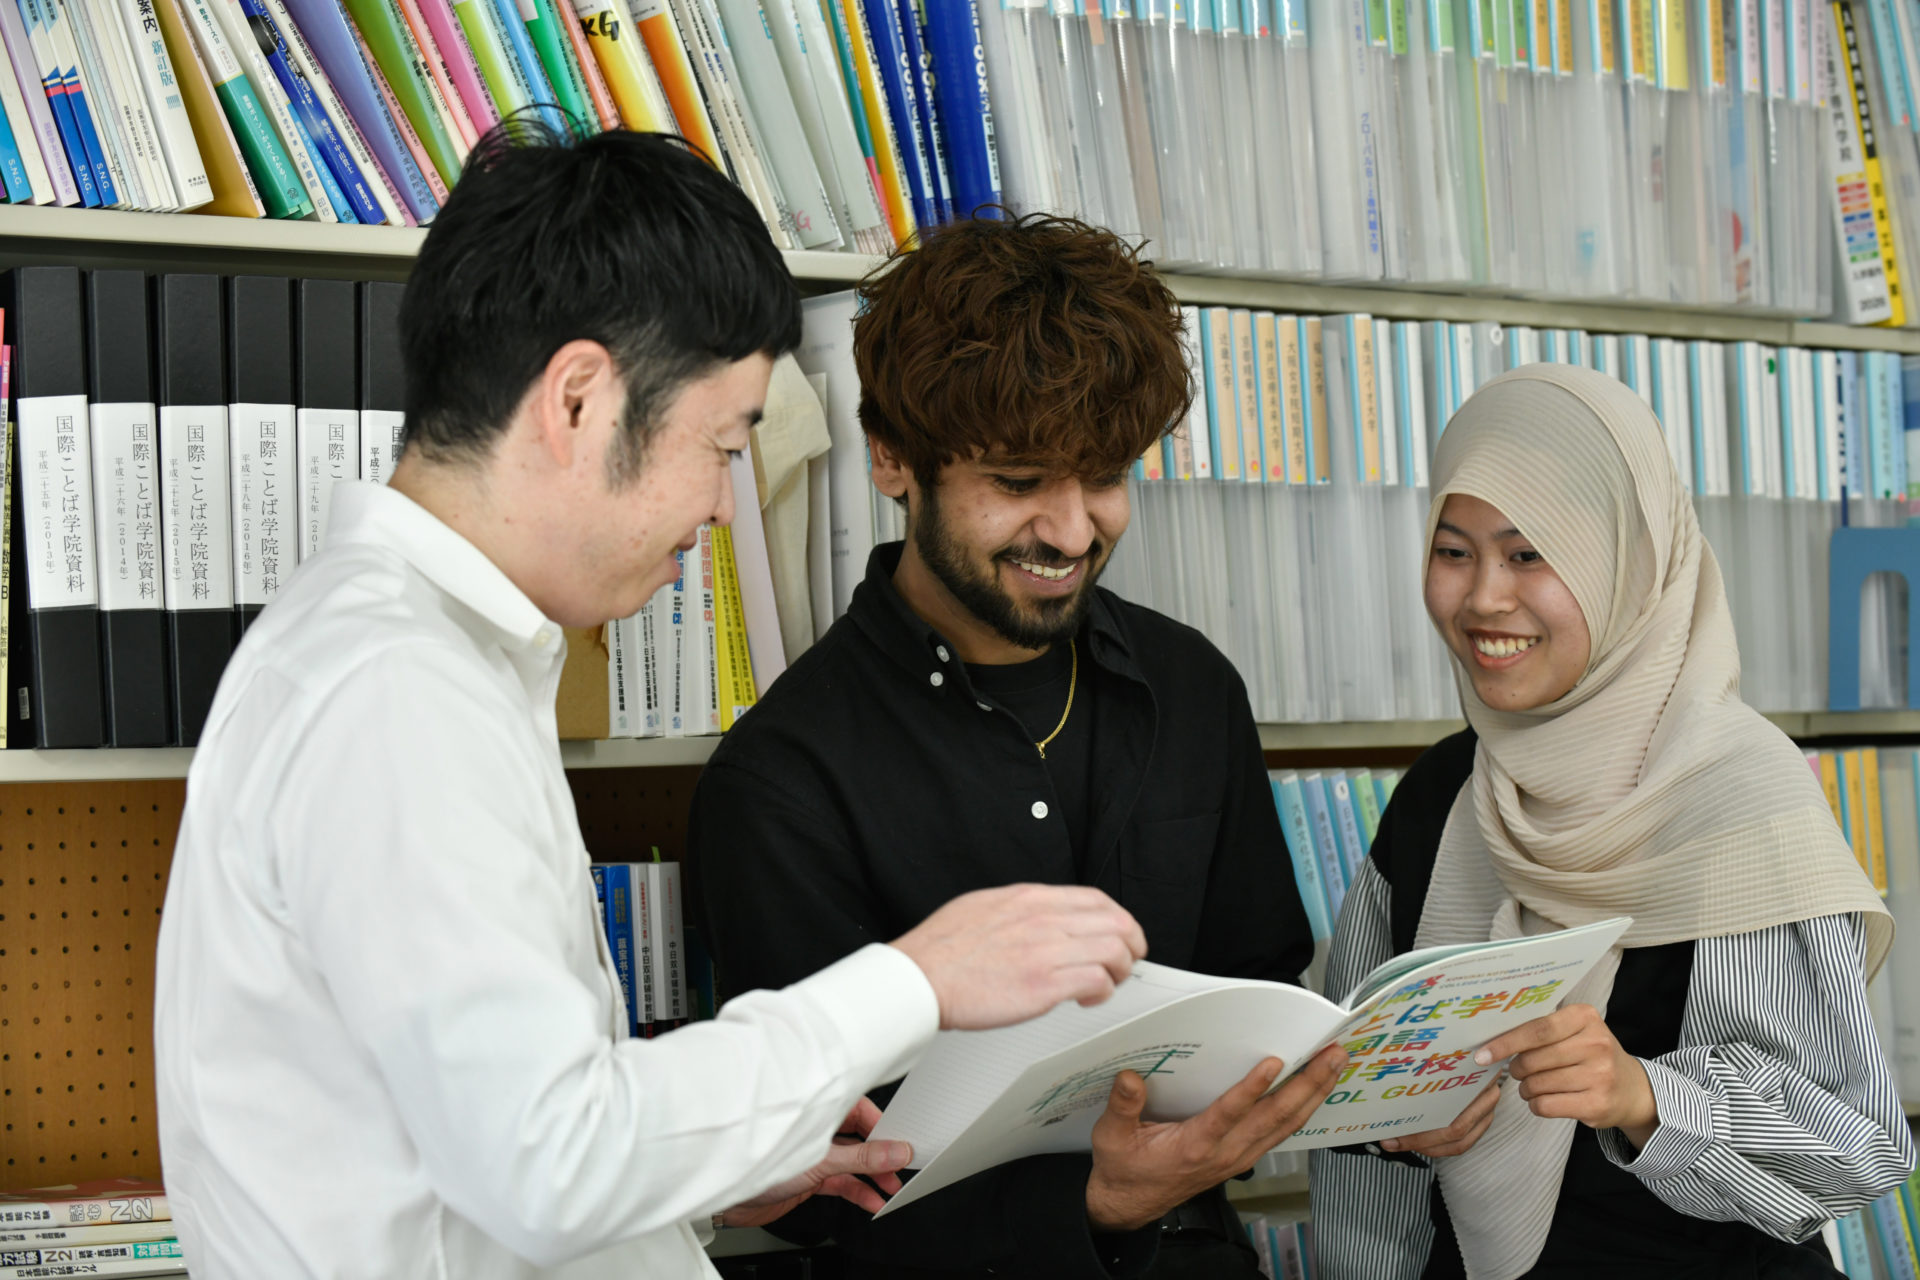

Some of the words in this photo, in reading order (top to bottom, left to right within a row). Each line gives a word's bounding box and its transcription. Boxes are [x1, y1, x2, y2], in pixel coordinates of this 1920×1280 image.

[8, 159, 22, 189] S.N.G.
[79, 164, 92, 194] S.N.G.
[97, 163, 110, 192] S.N.G.
[328, 424, 344, 479] 国際こ
[38, 450, 56, 574] 平成二十五年(2013年)
[56, 415, 85, 593] 国際ことば学院資料
[114, 457, 129, 580] 平成二十六年(2014年)
[132, 423, 157, 600] 国際ことば学院資料
[169, 458, 182, 581] 平成二十七年(2015年)
[187, 424, 210, 600] 国際ことば学院資料
[241, 453, 252, 575] 平成二十八年(2016年)
[260, 421, 280, 595] 国際ことば学院資料
[616, 649, 625, 711] 日本学生支援機構
[644, 648, 652, 710] 日本学生支援機構
[1380, 1069, 1489, 1101] GUIDE
[1333, 1113, 1425, 1135] FUTURE!!!
[108, 1198, 154, 1222] N2
[16, 1263, 98, 1277] 日本語能力試験ドリル
[44, 1250, 73, 1263] N2
